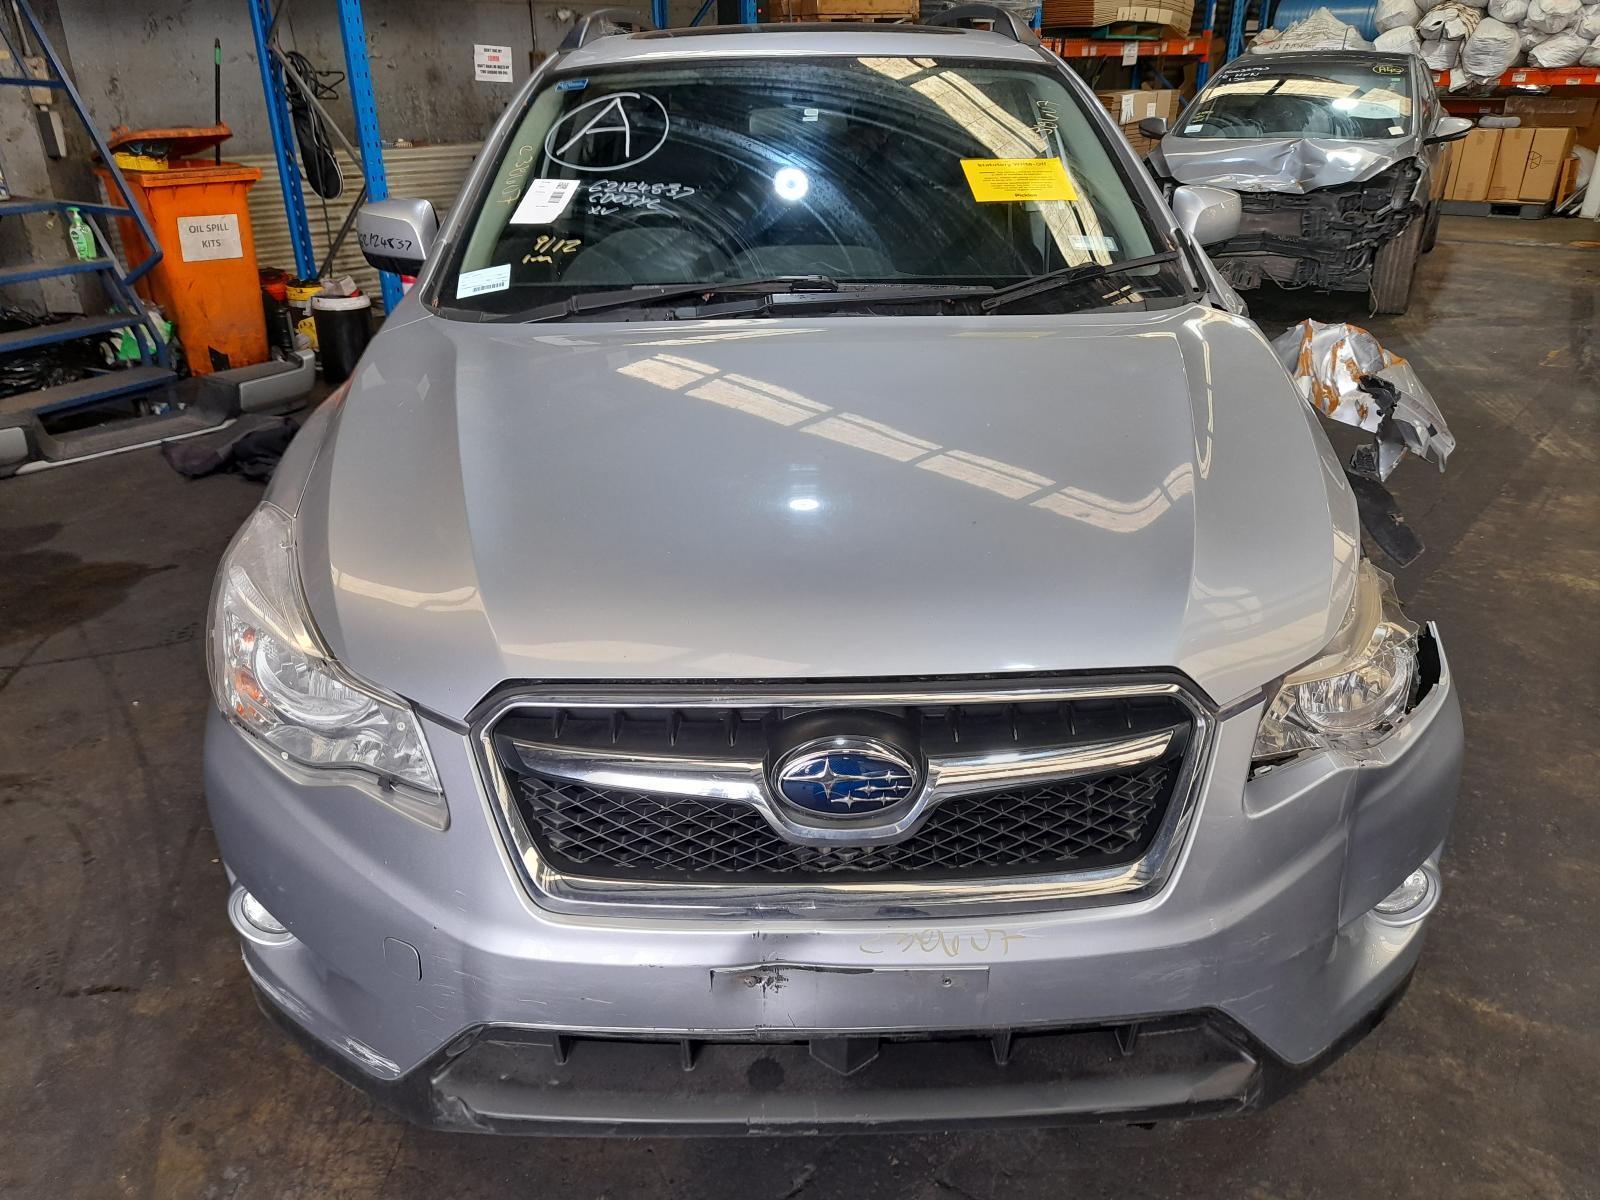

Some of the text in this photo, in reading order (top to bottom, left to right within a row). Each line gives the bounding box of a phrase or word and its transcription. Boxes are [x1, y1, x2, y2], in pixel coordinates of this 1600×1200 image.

[556, 97, 631, 158] A
[188, 223, 229, 233] OIL SPILL
[201, 239, 222, 248] KITS
